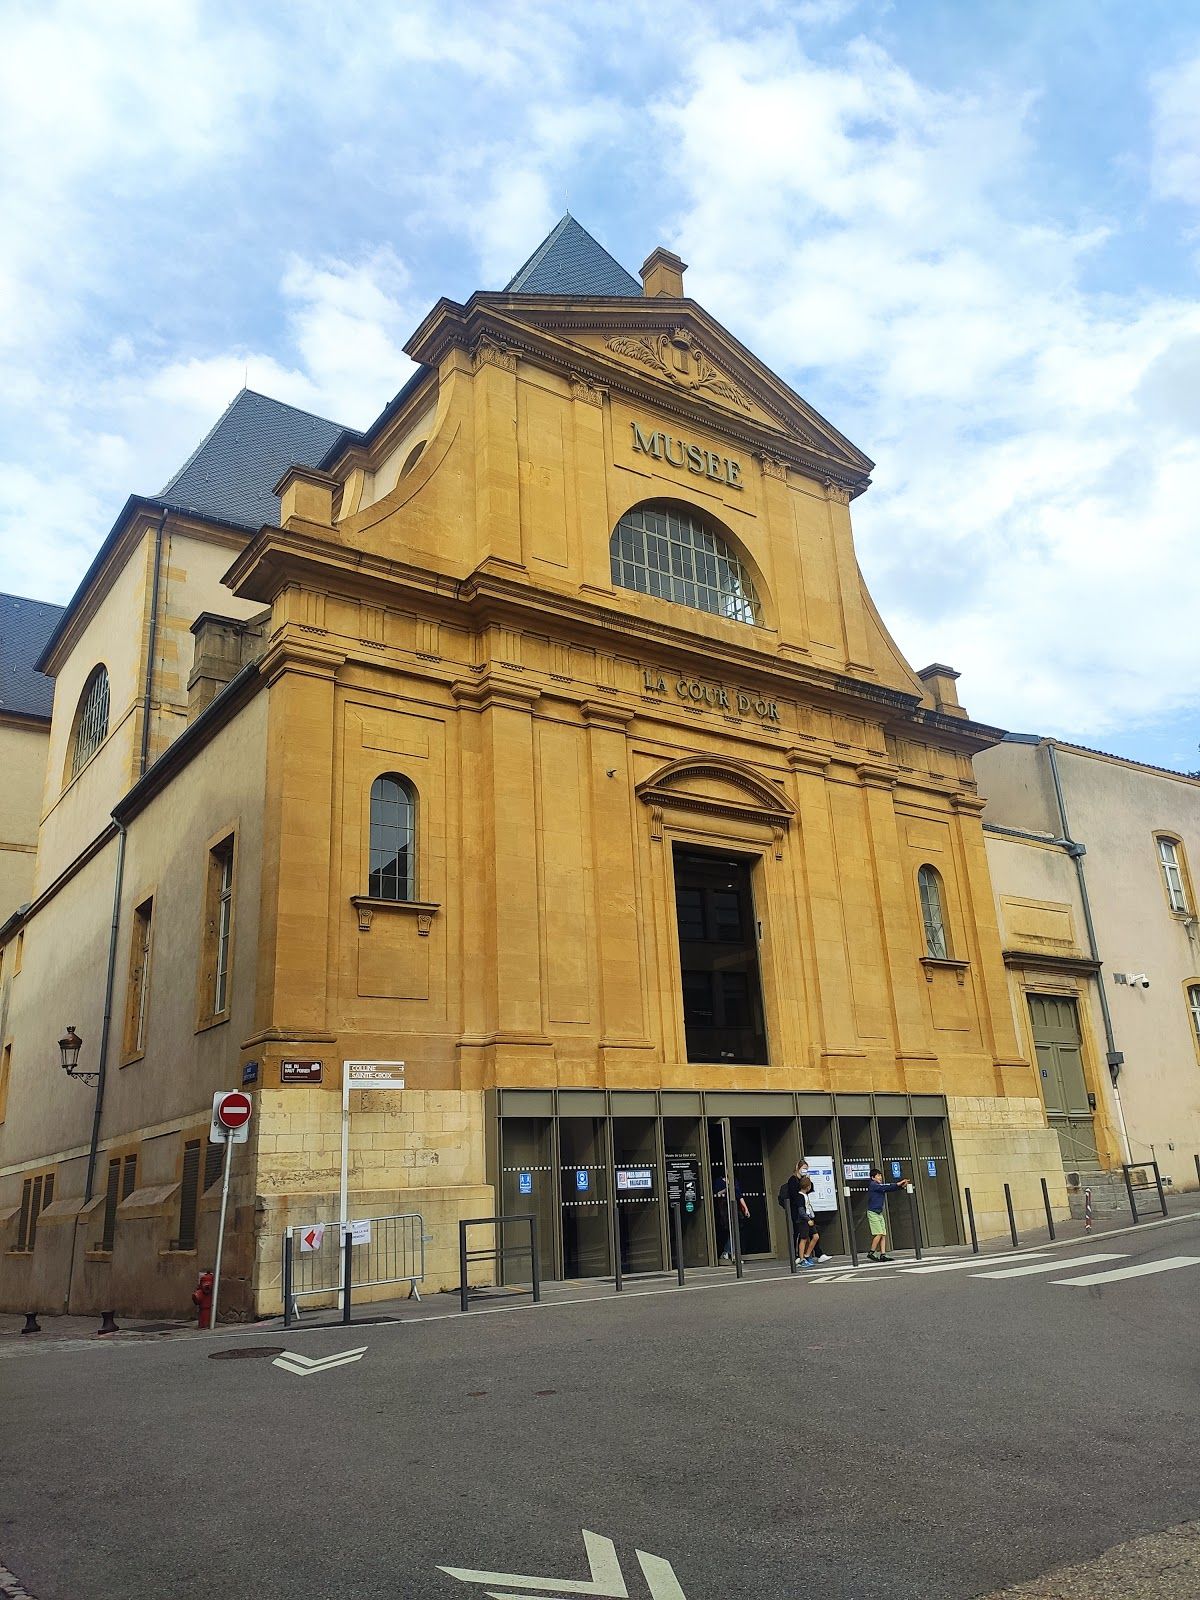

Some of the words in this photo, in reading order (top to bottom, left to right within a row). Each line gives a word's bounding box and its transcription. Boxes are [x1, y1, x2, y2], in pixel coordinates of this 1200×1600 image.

[631, 421, 743, 490] MUSEE
[644, 669, 667, 692] LA
[676, 679, 730, 709] COUR
